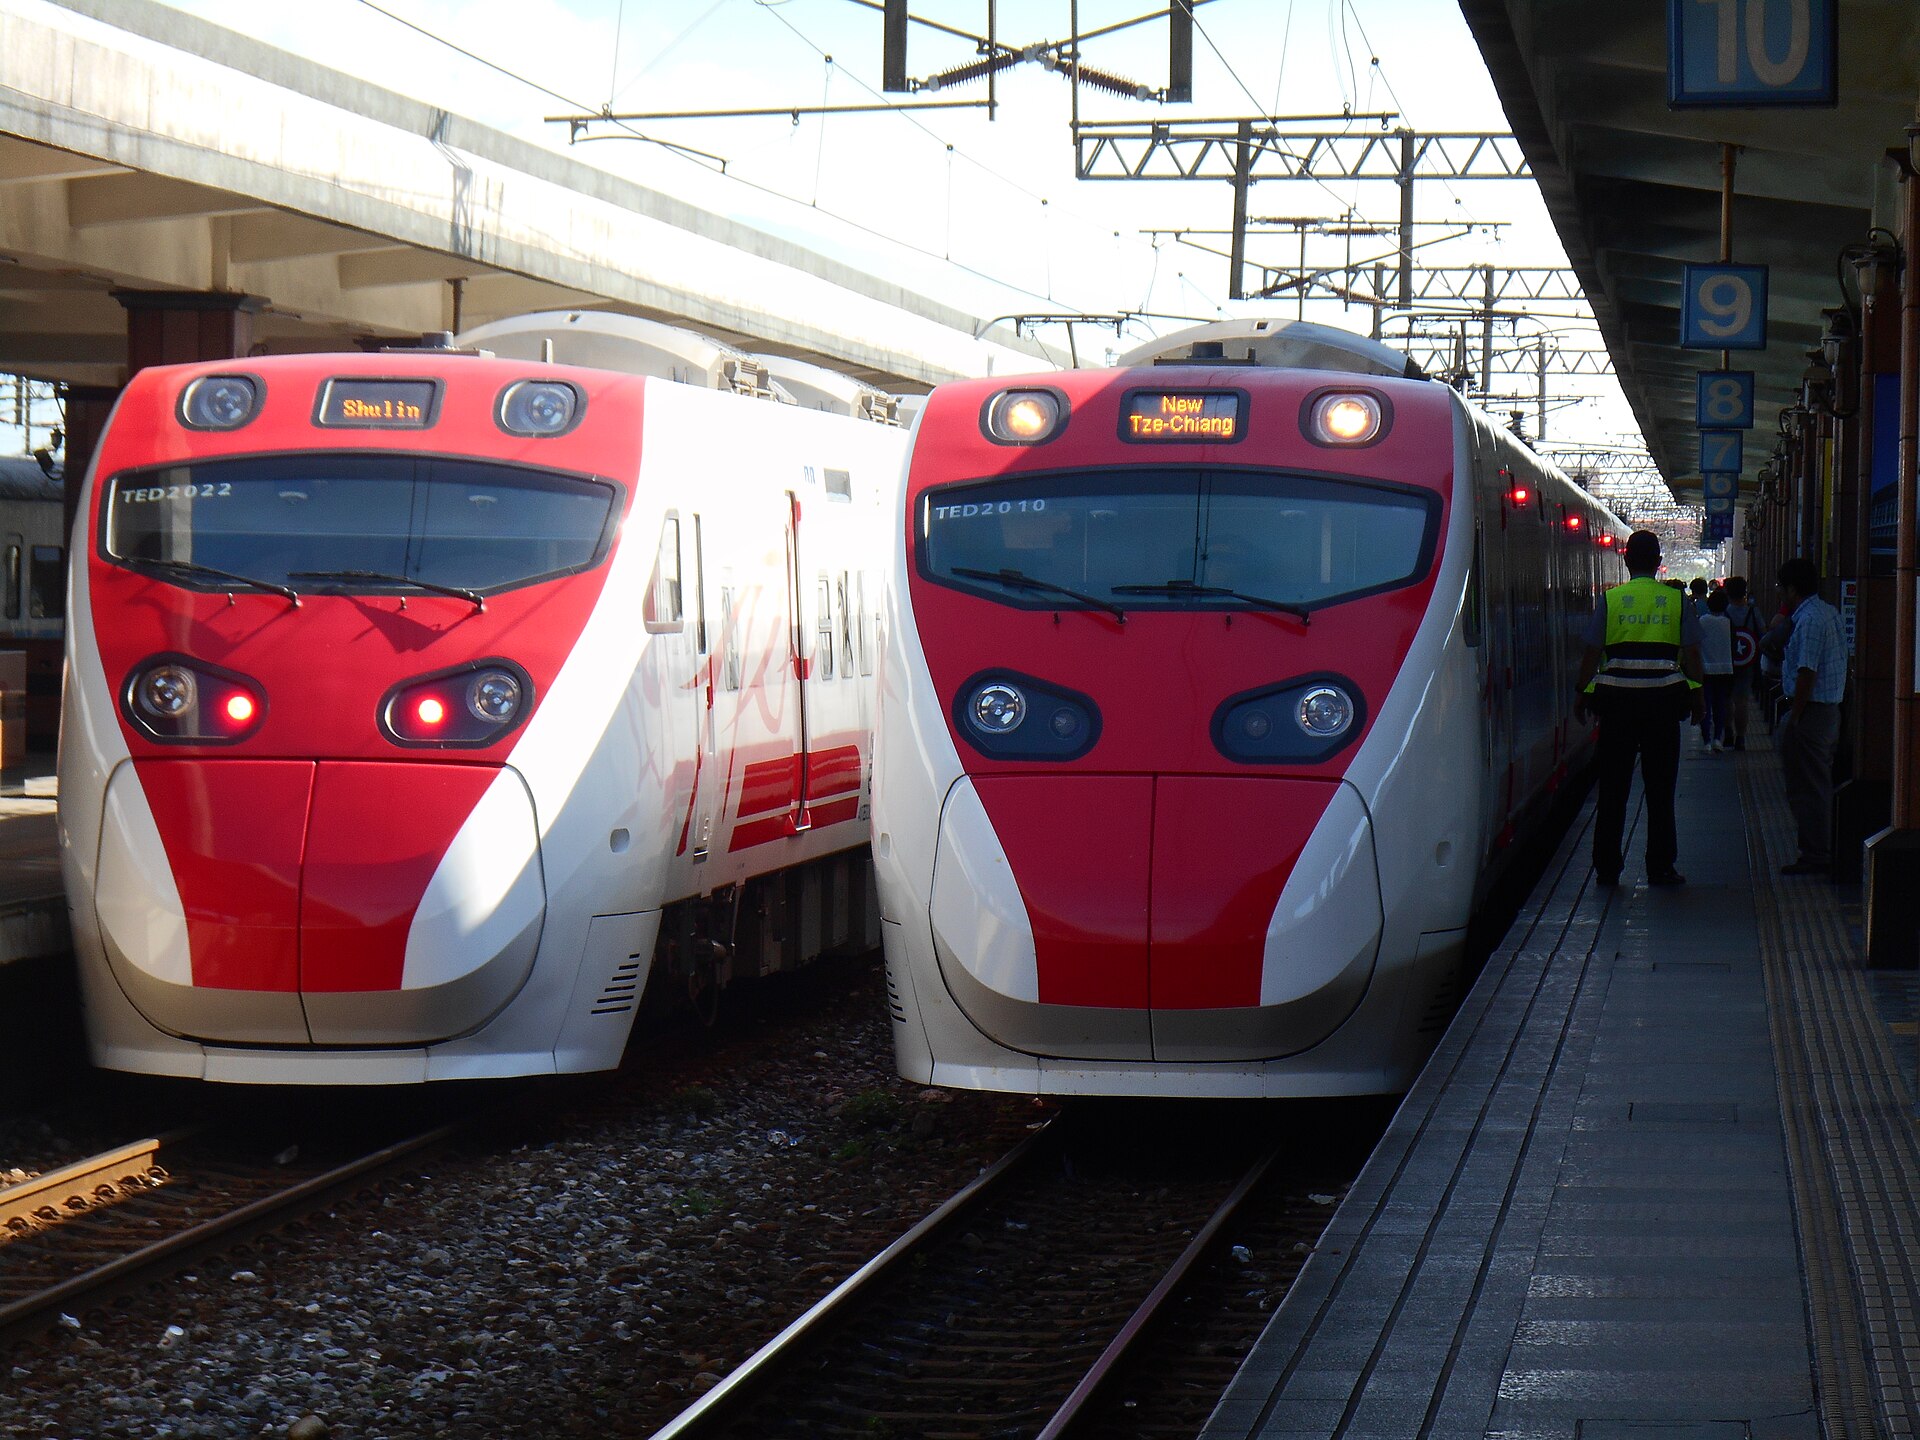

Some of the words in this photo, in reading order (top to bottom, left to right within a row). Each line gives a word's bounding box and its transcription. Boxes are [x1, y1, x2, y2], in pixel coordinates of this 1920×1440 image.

[1696, 0, 1810, 86] 10
[1699, 275, 1752, 337] 9
[343, 400, 420, 418] Shulin
[1162, 396, 1203, 413] New
[1708, 379, 1744, 420] 8
[1129, 415, 1233, 435] Tze-Chiang
[1708, 436, 1735, 470] 7
[121, 483, 231, 503] TED2022
[1710, 473, 1732, 495] 6
[936, 499, 1046, 520] TED2010
[1618, 614, 1670, 624] POLICE
